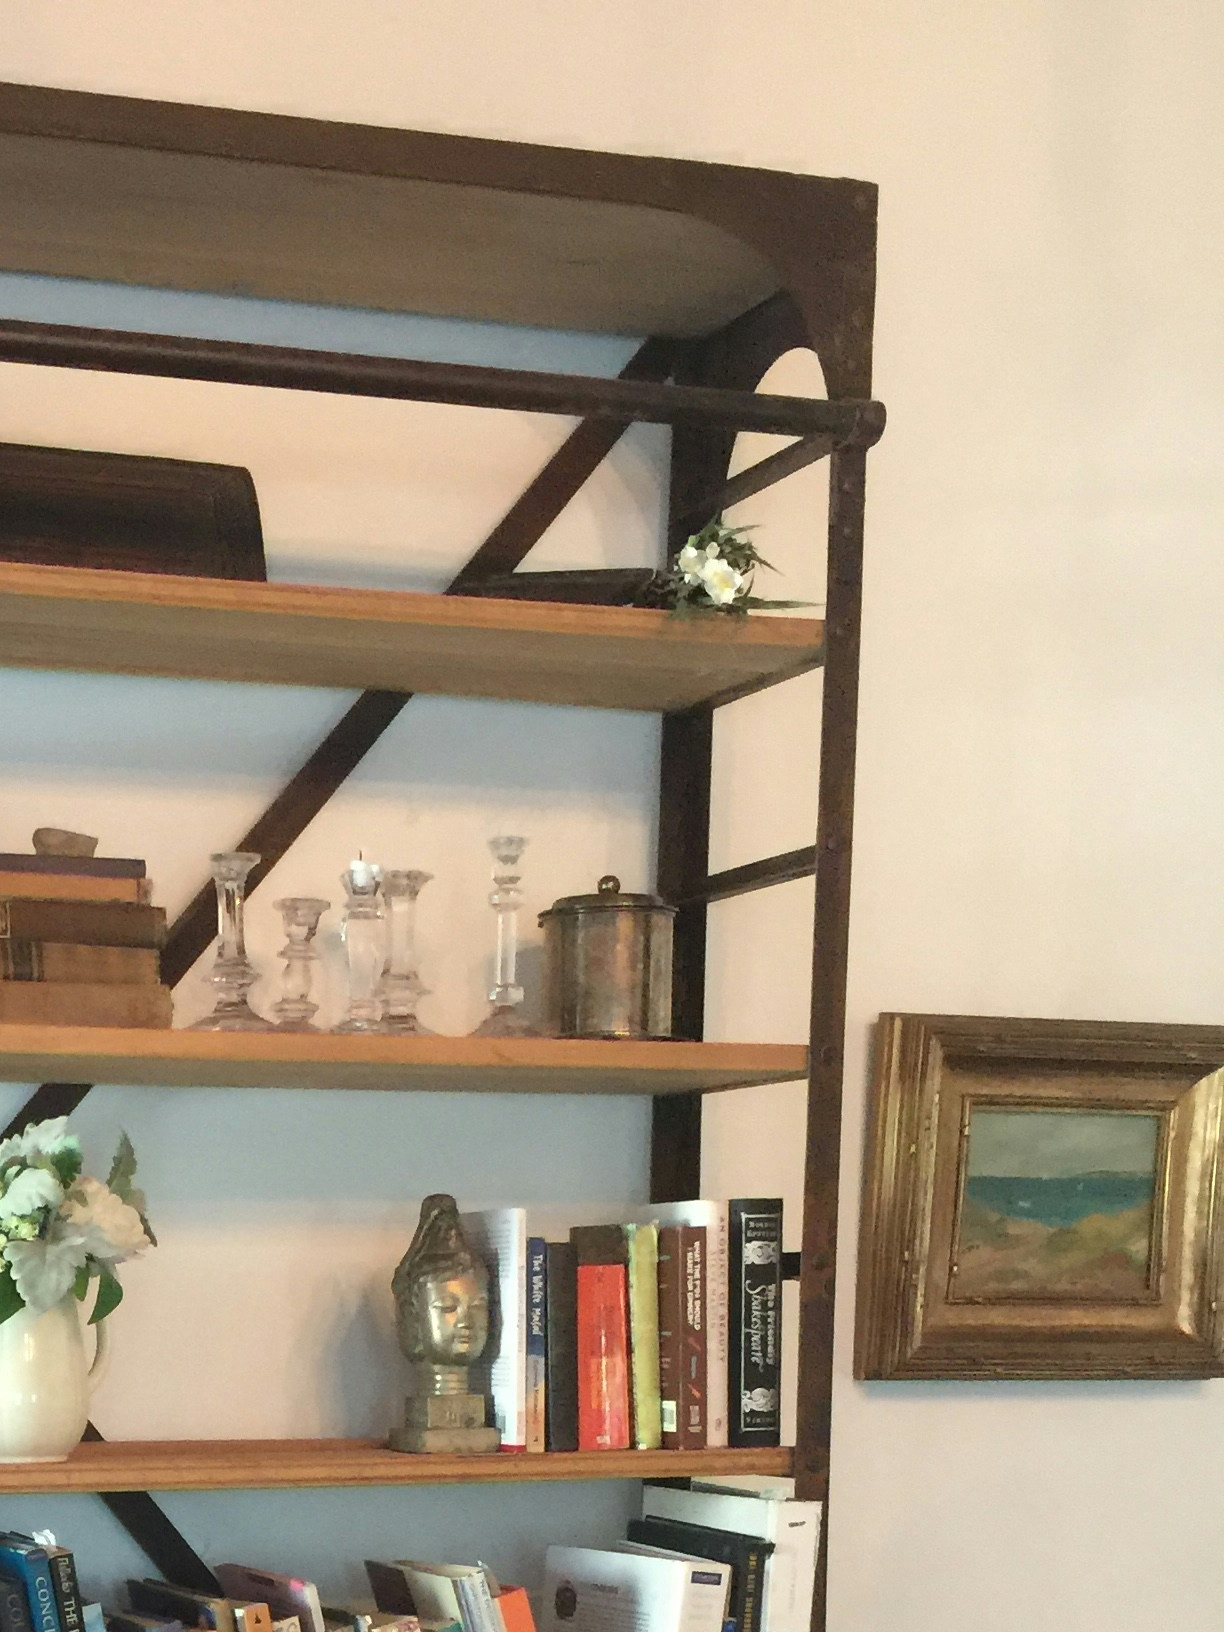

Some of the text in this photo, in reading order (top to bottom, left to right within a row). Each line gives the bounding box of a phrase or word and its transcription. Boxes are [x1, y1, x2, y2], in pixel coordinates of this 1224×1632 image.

[718, 1216, 724, 1232] AN
[532, 1253, 543, 1272] The
[531, 1275, 542, 1303] White
[62, 1599, 78, 1623] THE
